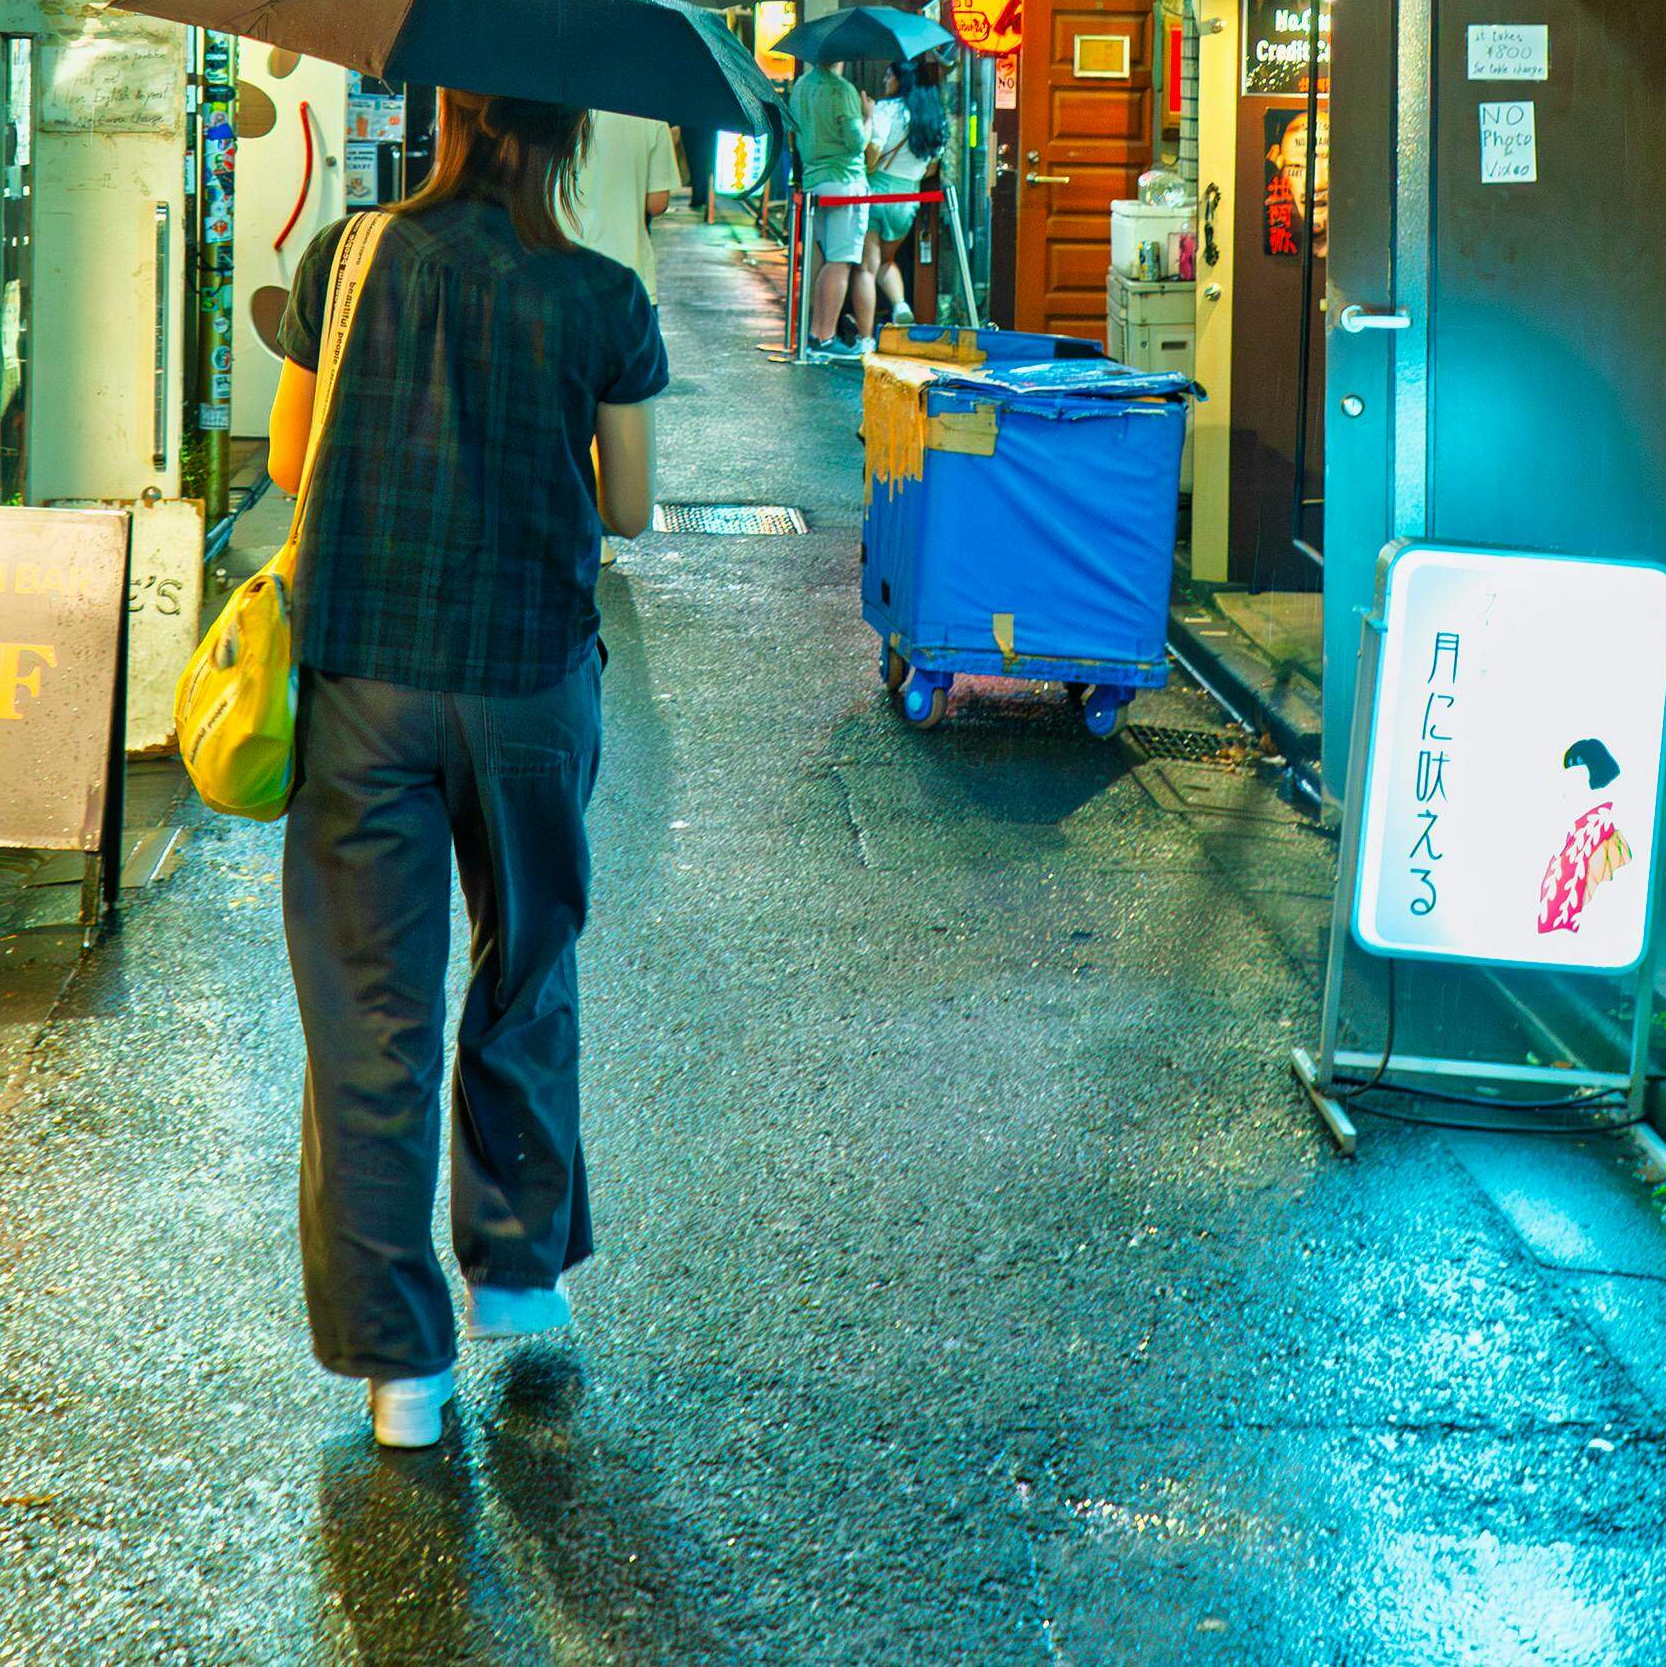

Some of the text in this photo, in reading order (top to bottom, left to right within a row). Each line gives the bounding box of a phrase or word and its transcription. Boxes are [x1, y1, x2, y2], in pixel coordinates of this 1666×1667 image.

[1483, 105, 1524, 126] NO
[332, 332, 344, 365] people
[14, 563, 95, 598] BAR
[1409, 631, 1460, 916] 月に吠える
